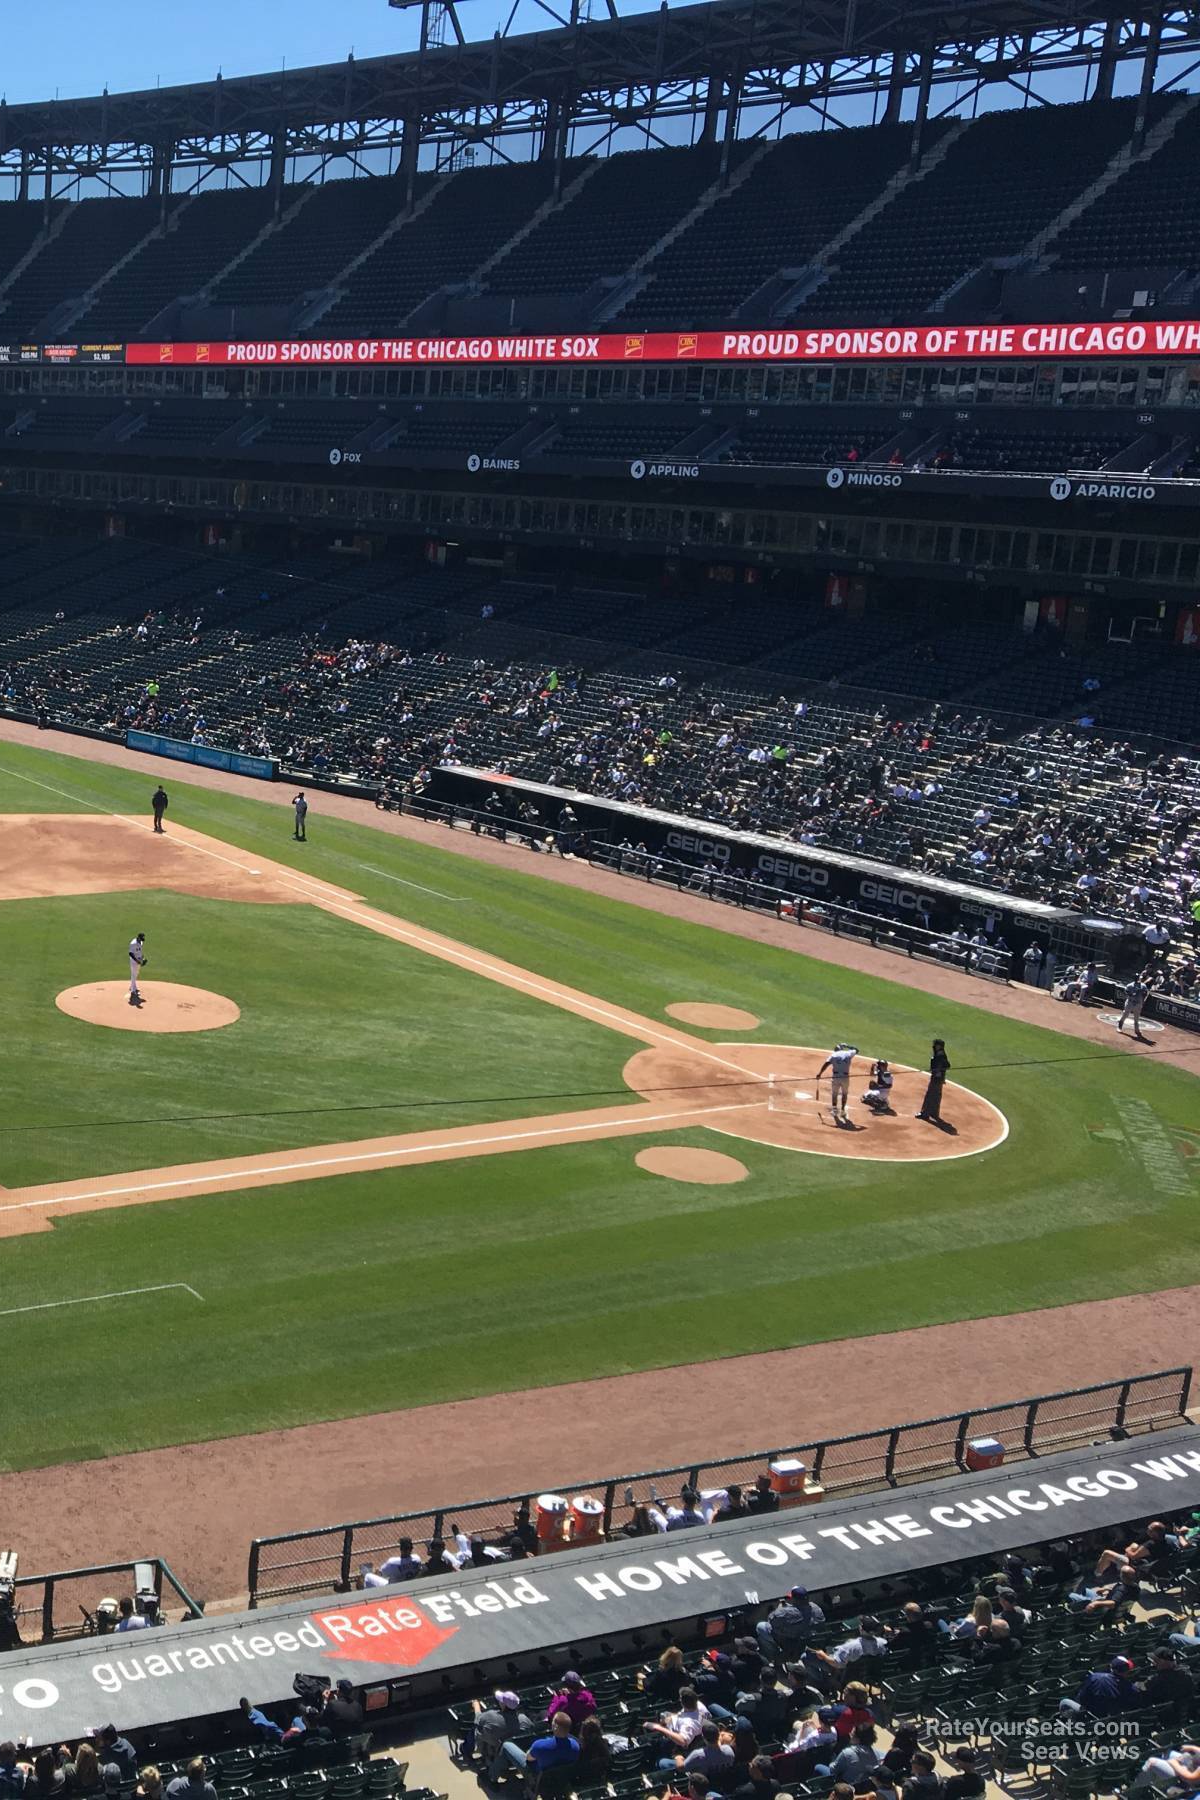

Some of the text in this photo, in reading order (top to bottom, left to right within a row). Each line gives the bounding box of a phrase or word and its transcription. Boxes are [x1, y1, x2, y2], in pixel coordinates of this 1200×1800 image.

[0, 345, 11, 353] OAK
[227, 337, 600, 361] PROUD SPONSOR OF THE CHICAGO WHITE SOX
[723, 333, 799, 355] PROUD
[805, 330, 918, 354] SPONSOR
[925, 329, 958, 353] OF
[964, 328, 1016, 352] THE
[1021, 325, 1147, 352] CHICAGO
[332, 452, 362, 463] 2 FOX
[470, 458, 521, 470] 3 BAINES
[633, 464, 699, 477] 4 APPLING
[830, 472, 902, 487] 9 MINOSO
[1054, 483, 1156, 500] 11 APARICIO
[666, 831, 732, 861] GEICO
[757, 854, 830, 887] GEICO
[959, 902, 1004, 921] GEICO
[574, 1549, 746, 1602] HOME
[744, 1533, 819, 1567] OF
[817, 1513, 934, 1551] THE
[929, 1468, 1143, 1530] CHICAGO
[91, 1576, 551, 1694] guaranteed Rate Field
